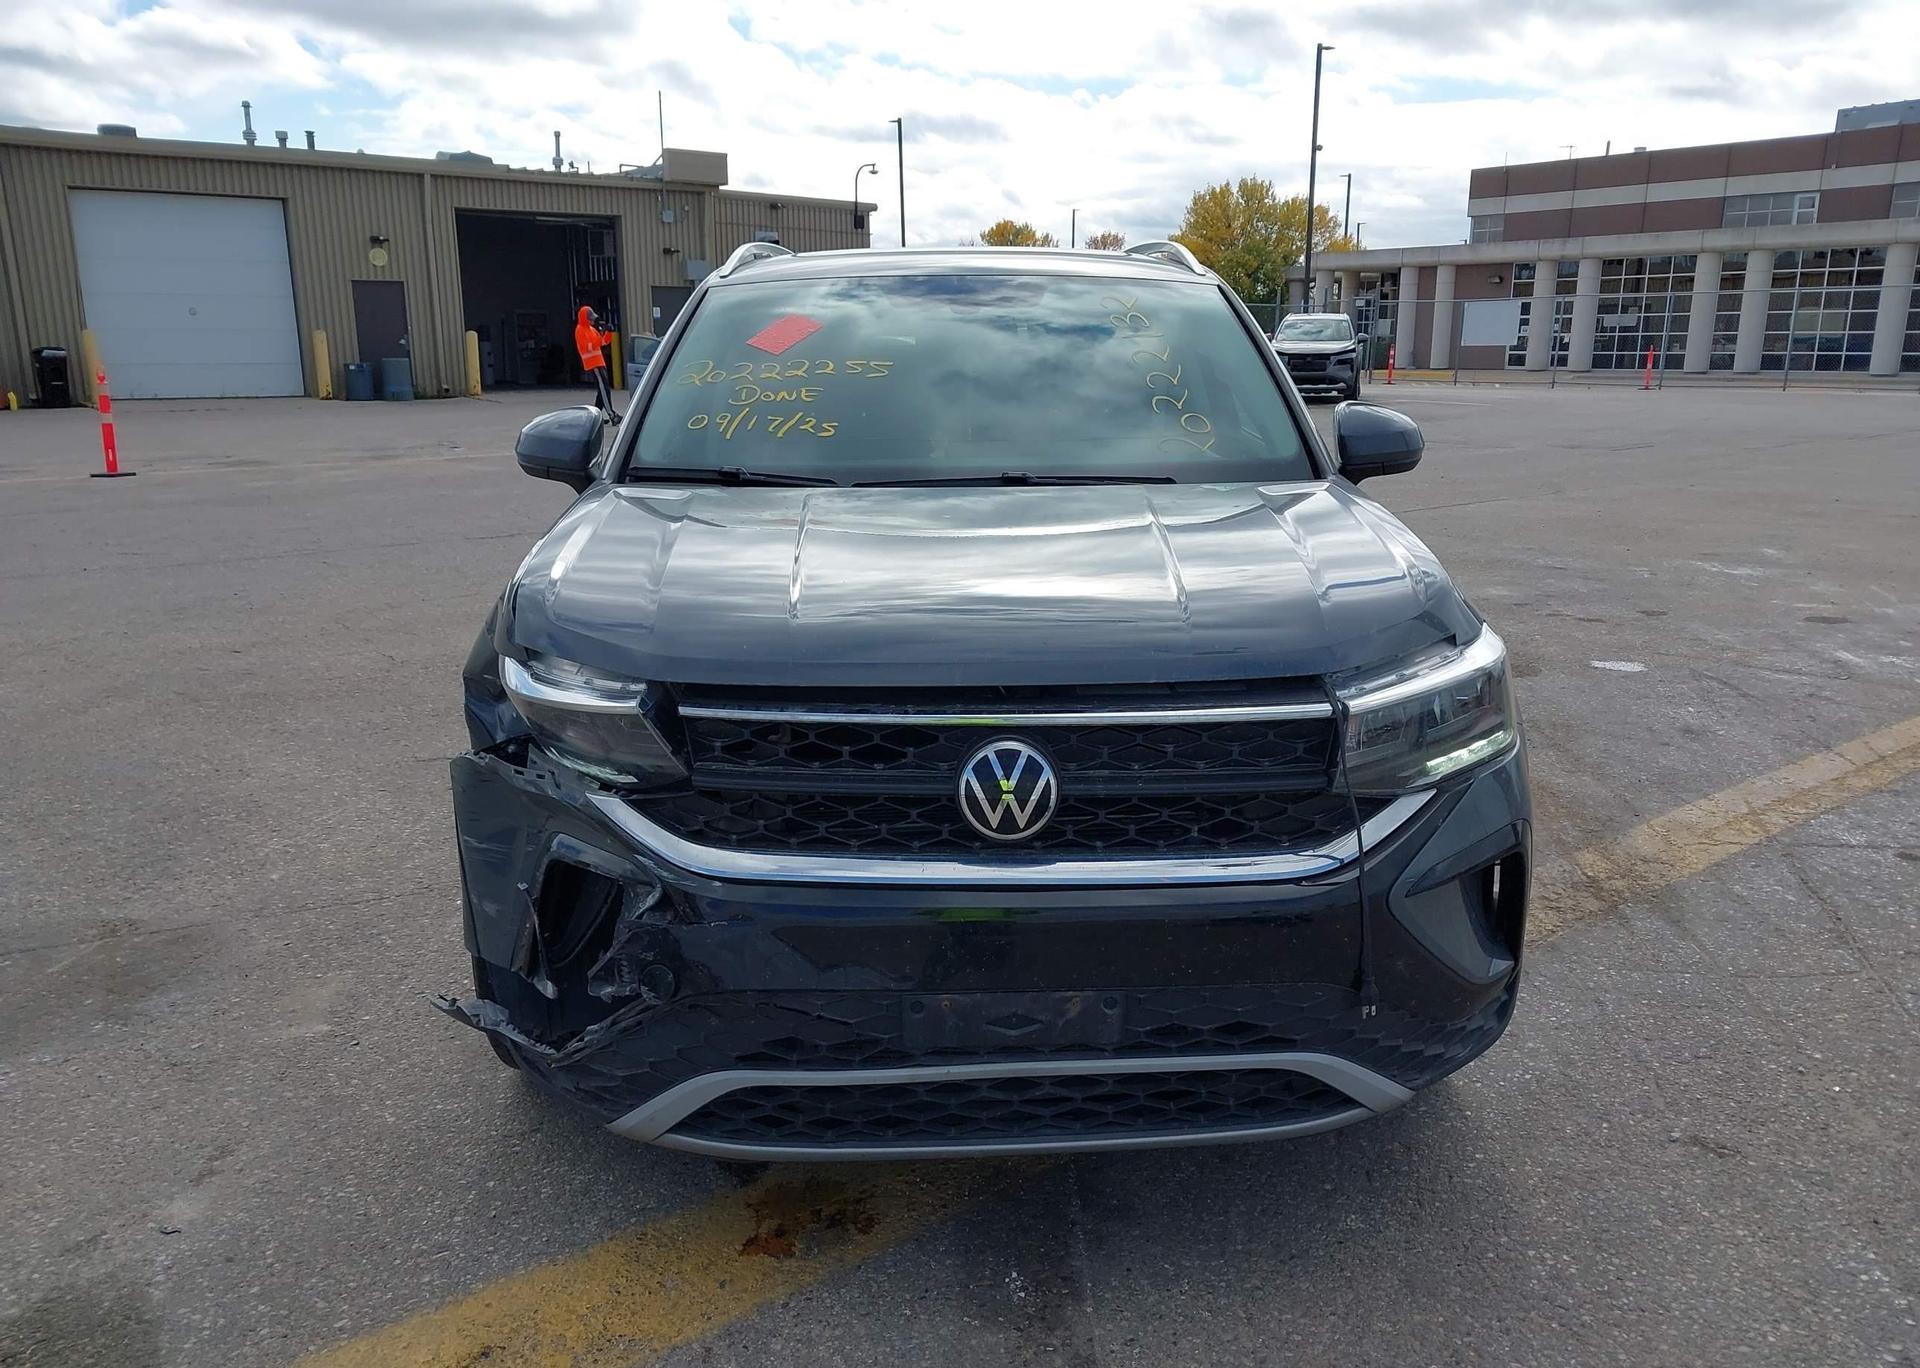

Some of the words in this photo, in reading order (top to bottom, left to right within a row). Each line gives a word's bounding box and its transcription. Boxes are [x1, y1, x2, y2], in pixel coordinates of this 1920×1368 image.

[677, 359, 894, 385] 20222255
[728, 384, 825, 405] DONE
[687, 407, 839, 440] 09/17/25
[963, 745, 1052, 830] VW
